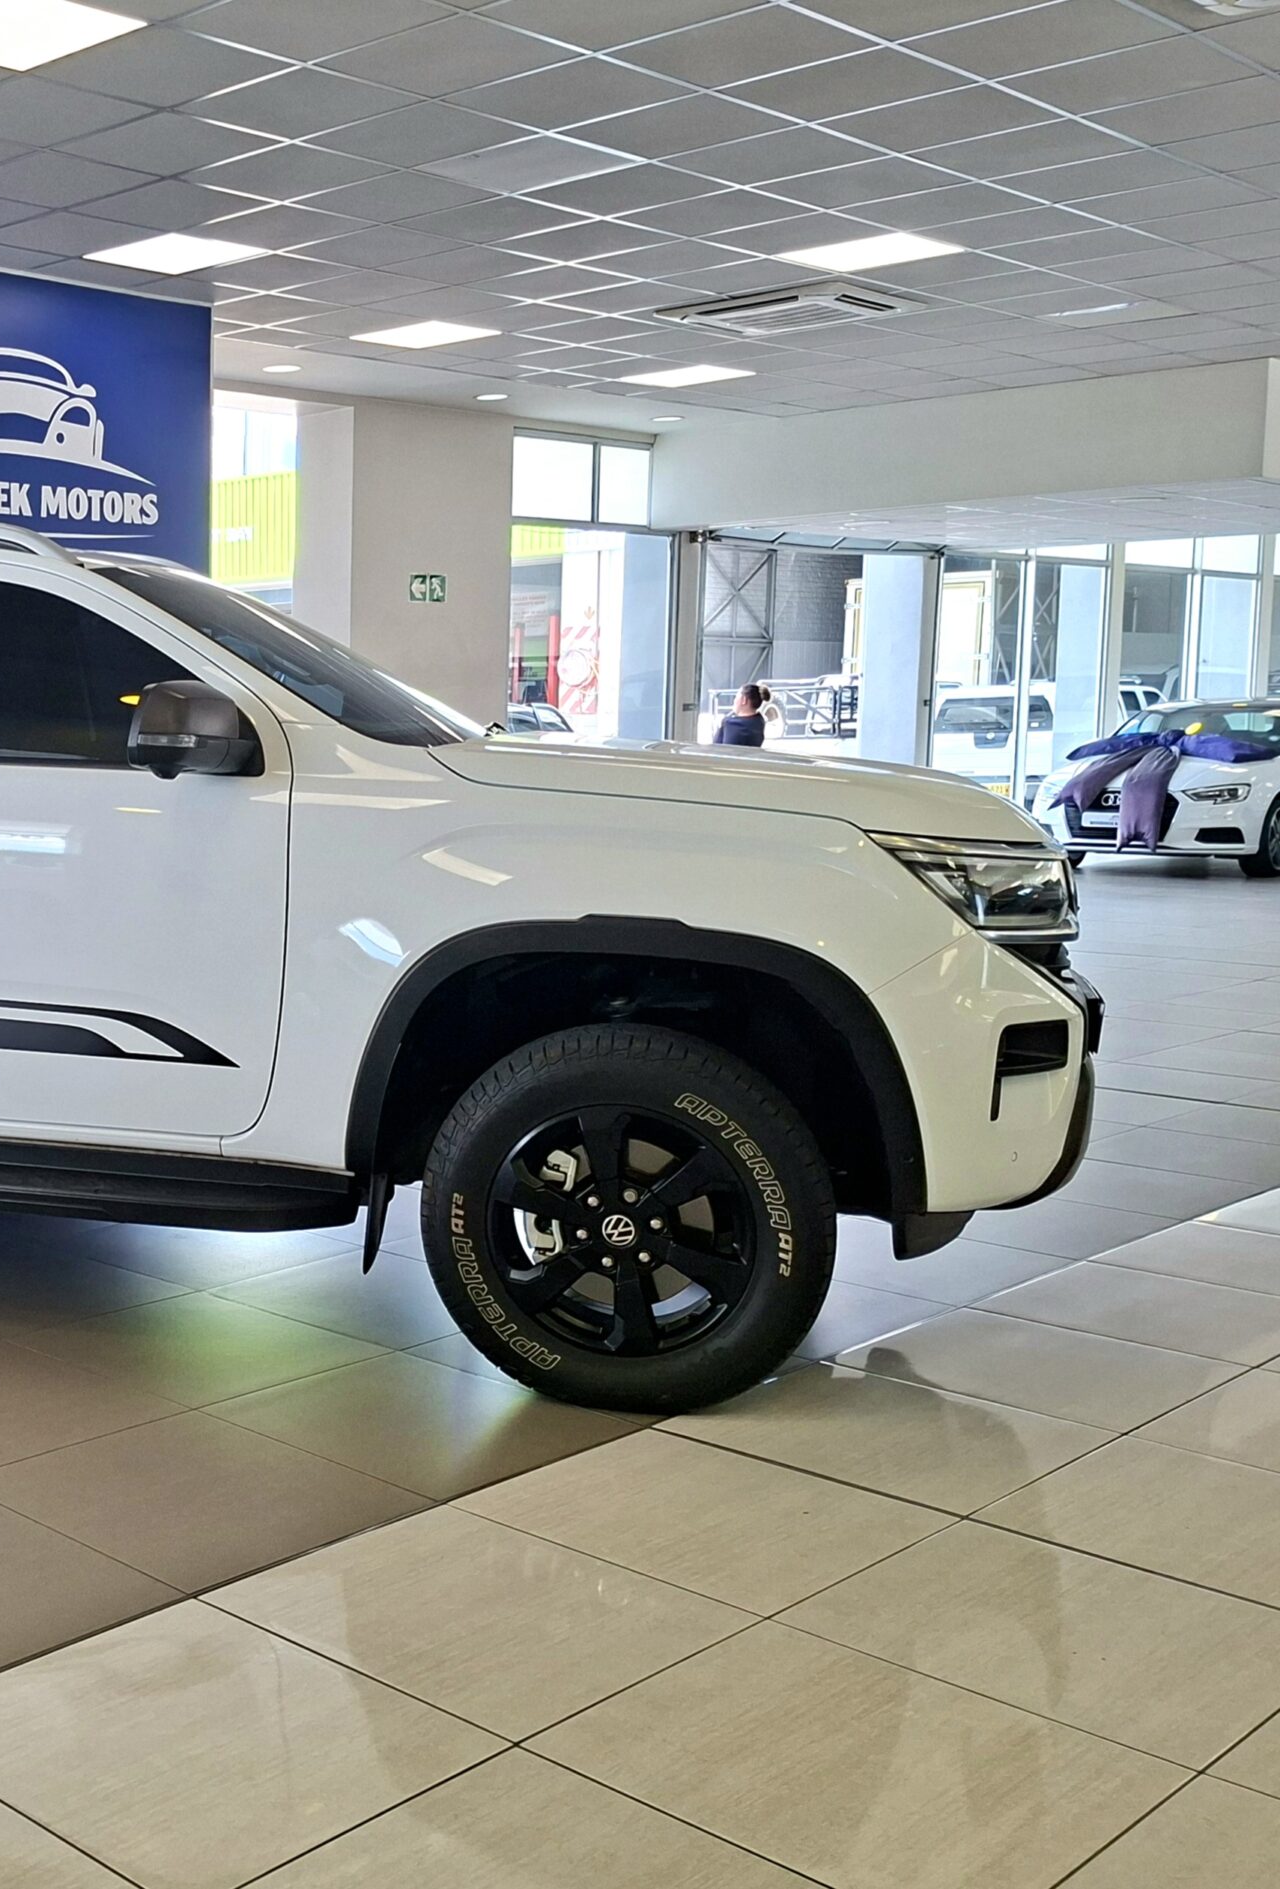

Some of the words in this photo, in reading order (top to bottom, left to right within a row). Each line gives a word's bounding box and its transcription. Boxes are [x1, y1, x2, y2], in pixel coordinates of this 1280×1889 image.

[41, 485, 159, 526] MOTORS
[673, 1092, 792, 1231] APTERRA
[452, 1236, 562, 1371] APTERRA
